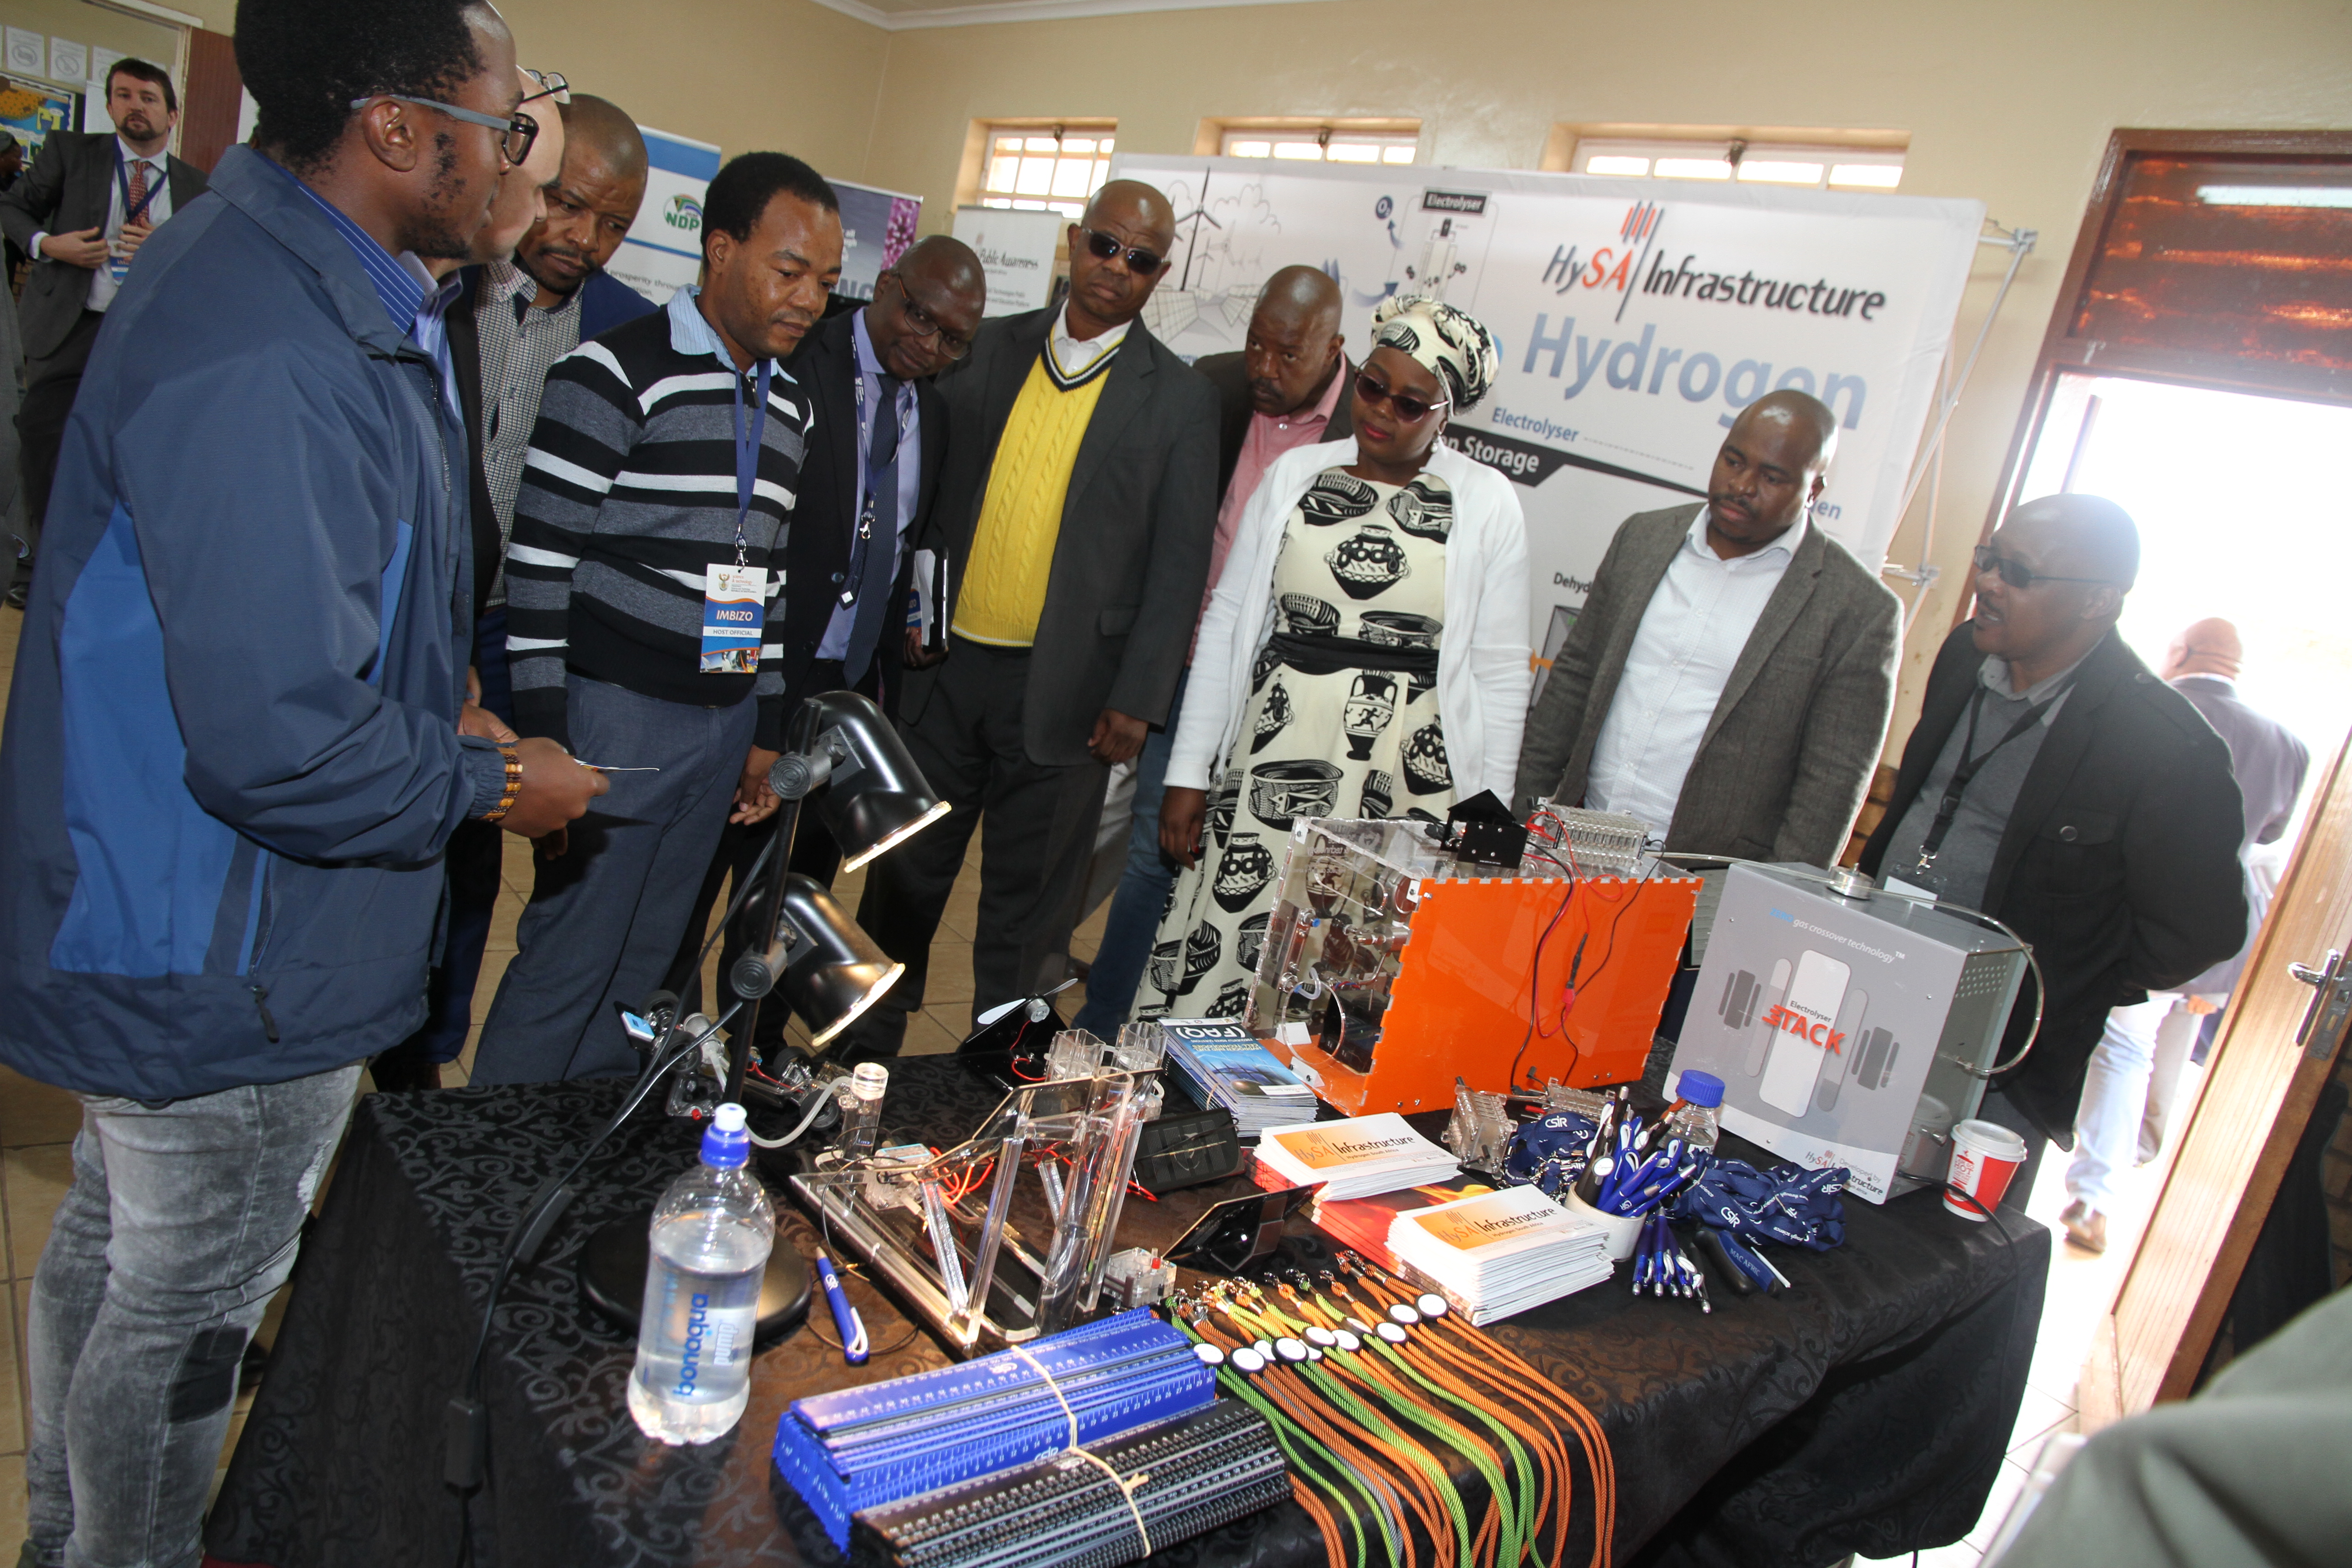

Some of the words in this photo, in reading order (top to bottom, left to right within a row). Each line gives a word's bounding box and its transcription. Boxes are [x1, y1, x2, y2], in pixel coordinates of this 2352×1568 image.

[1426, 193, 1483, 211] Electrolyser
[666, 211, 700, 231] NDP
[980, 248, 998, 265] Public
[1001, 251, 1039, 271] Awareness
[1542, 243, 1631, 295] HySA
[1642, 250, 1886, 321] Infrastructure
[1492, 407, 1580, 443] Electrolyser
[1462, 436, 1540, 475] Storage
[716, 610, 753, 622] IMBIZO
[1769, 908, 1794, 922] ZERO
[1793, 919, 1809, 930] gas
[1809, 925, 1847, 944] crossover
[1847, 939, 1895, 963] technology
[1790, 1000, 1832, 1022] Electrolyser
[1176, 1026, 1245, 1039] (FAQ)
[1545, 1115, 1568, 1128] CSIR
[1294, 1146, 1335, 1161] HySA
[1332, 1136, 1416, 1155] Infrastructure
[1805, 1151, 1827, 1168] HySA
[1840, 1158, 1873, 1177] Developed
[1873, 1174, 1882, 1183] by
[1699, 1184, 1715, 1198] science
[1821, 1184, 1843, 1195] CSIR
[1437, 1225, 1480, 1242] HySA
[1474, 1208, 1557, 1232] Infrastructure
[1720, 1206, 1741, 1228] CSIR
[1492, 1229, 1516, 1238] Hydrogen
[1773, 1226, 1791, 1237] science
[1730, 1248, 1744, 1263] MAC
[1743, 1259, 1761, 1277] AFRIC
[673, 1293, 710, 1396] bonaqua
[714, 1323, 739, 1367] pump
[987, 1459, 993, 1467] 10
[1034, 1440, 1040, 1448] 14
[1046, 1436, 1052, 1444] 15
